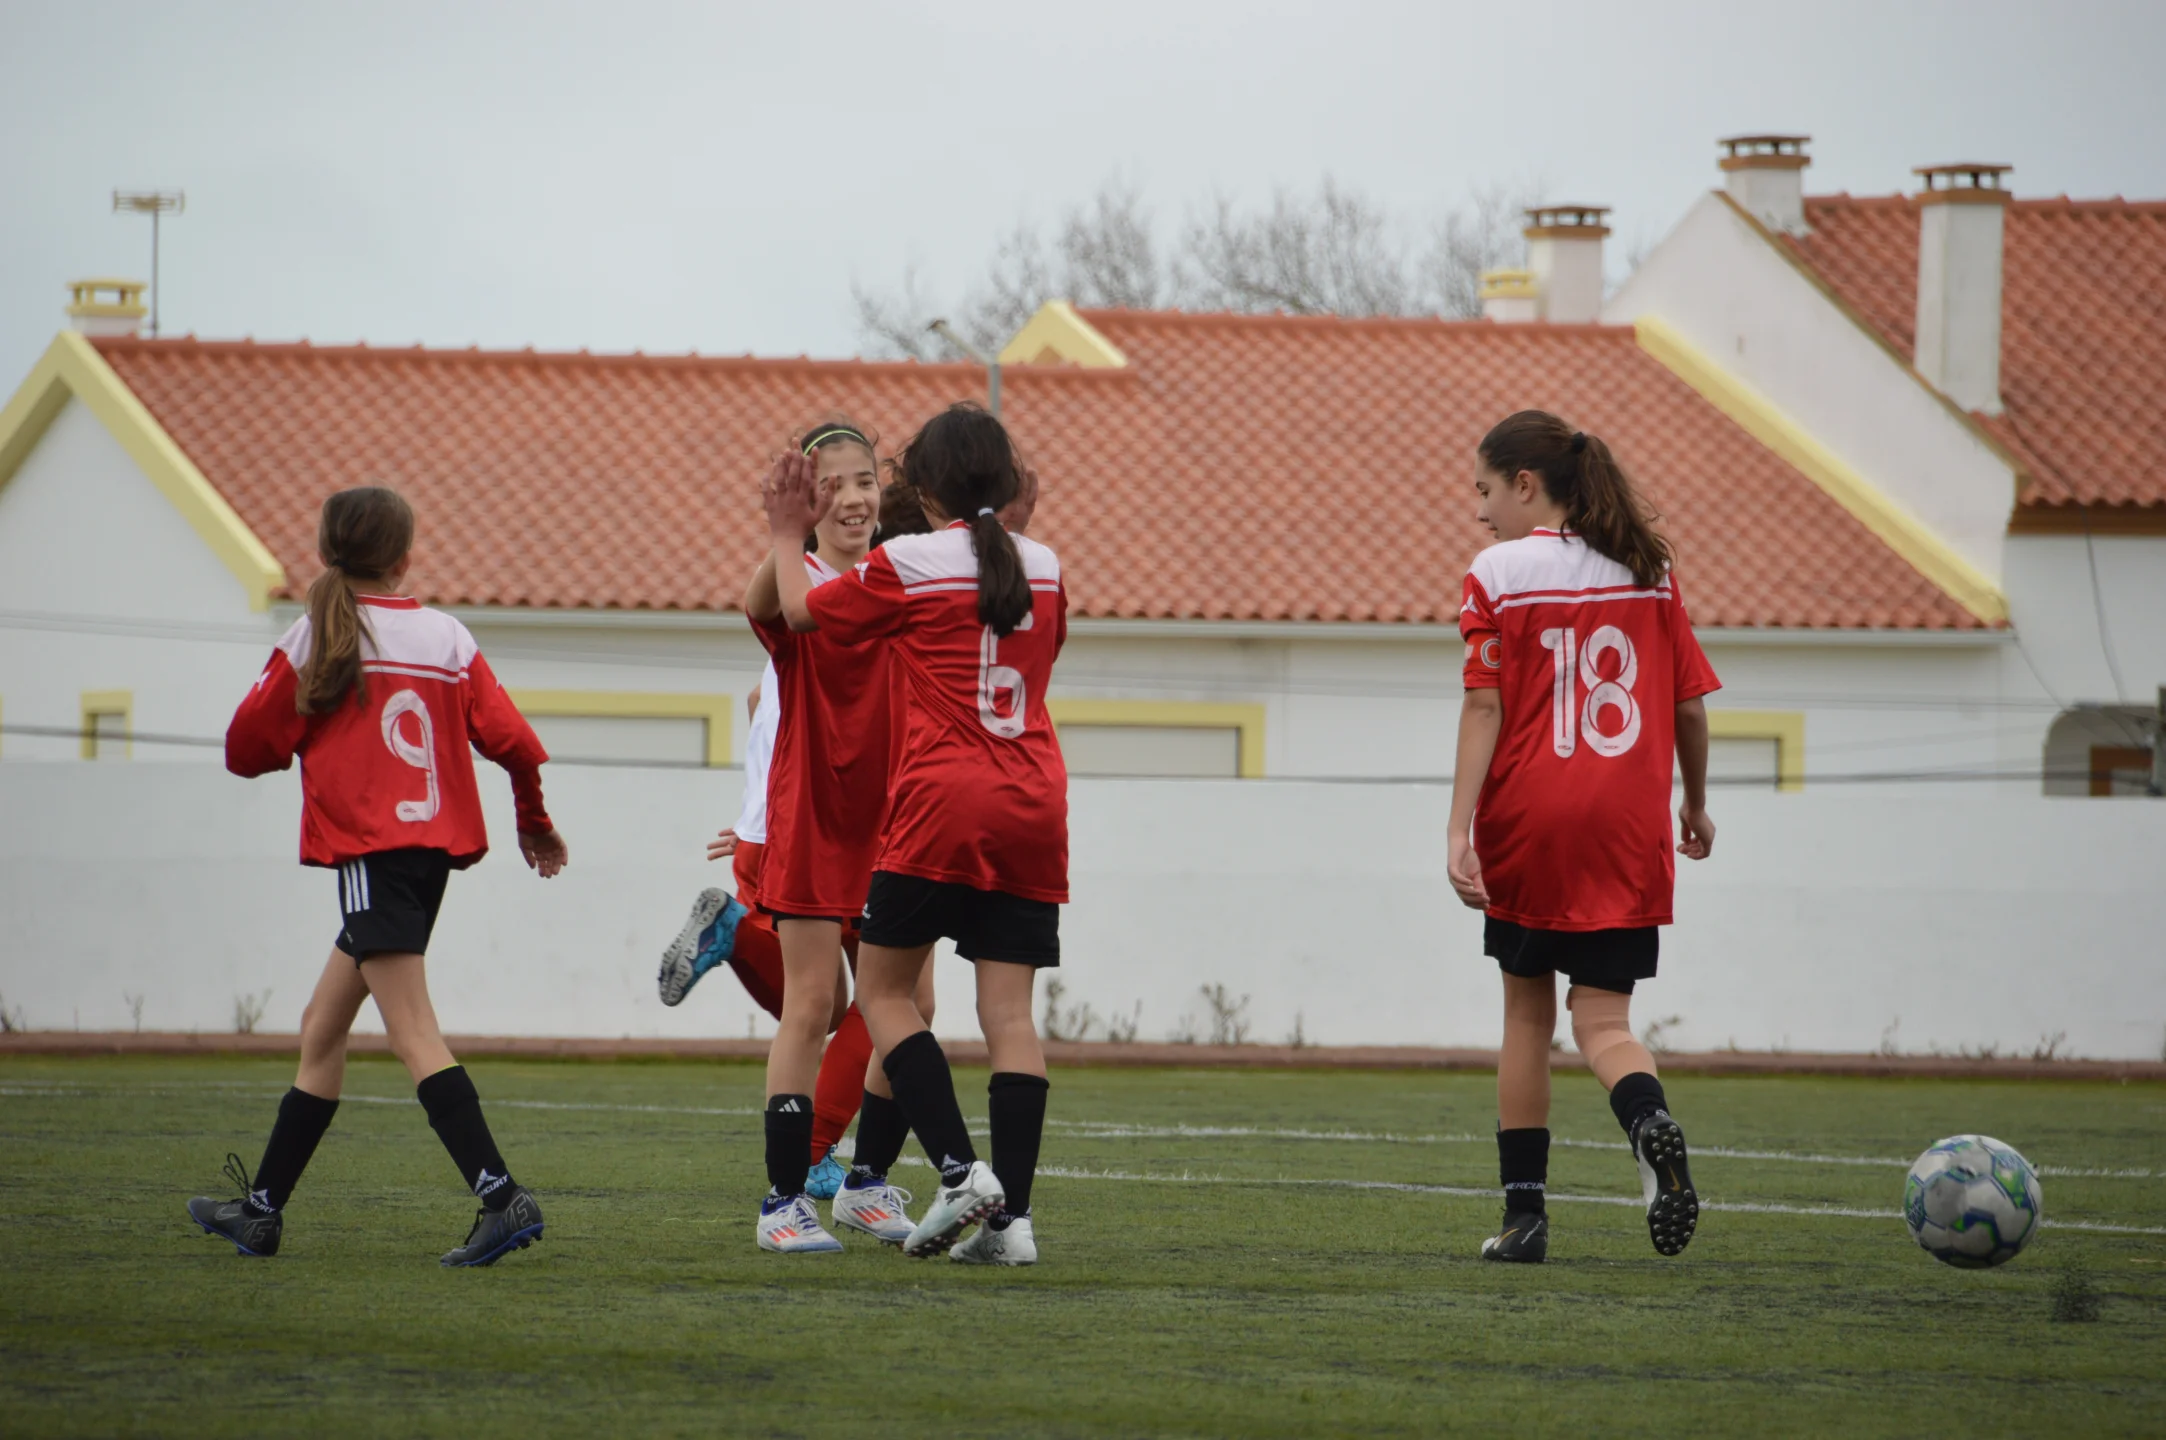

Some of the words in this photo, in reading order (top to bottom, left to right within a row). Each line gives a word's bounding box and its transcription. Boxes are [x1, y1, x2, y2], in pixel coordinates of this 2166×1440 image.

[977, 610, 1034, 739] 6
[1540, 624, 1642, 758] 18
[380, 689, 441, 822] 9
